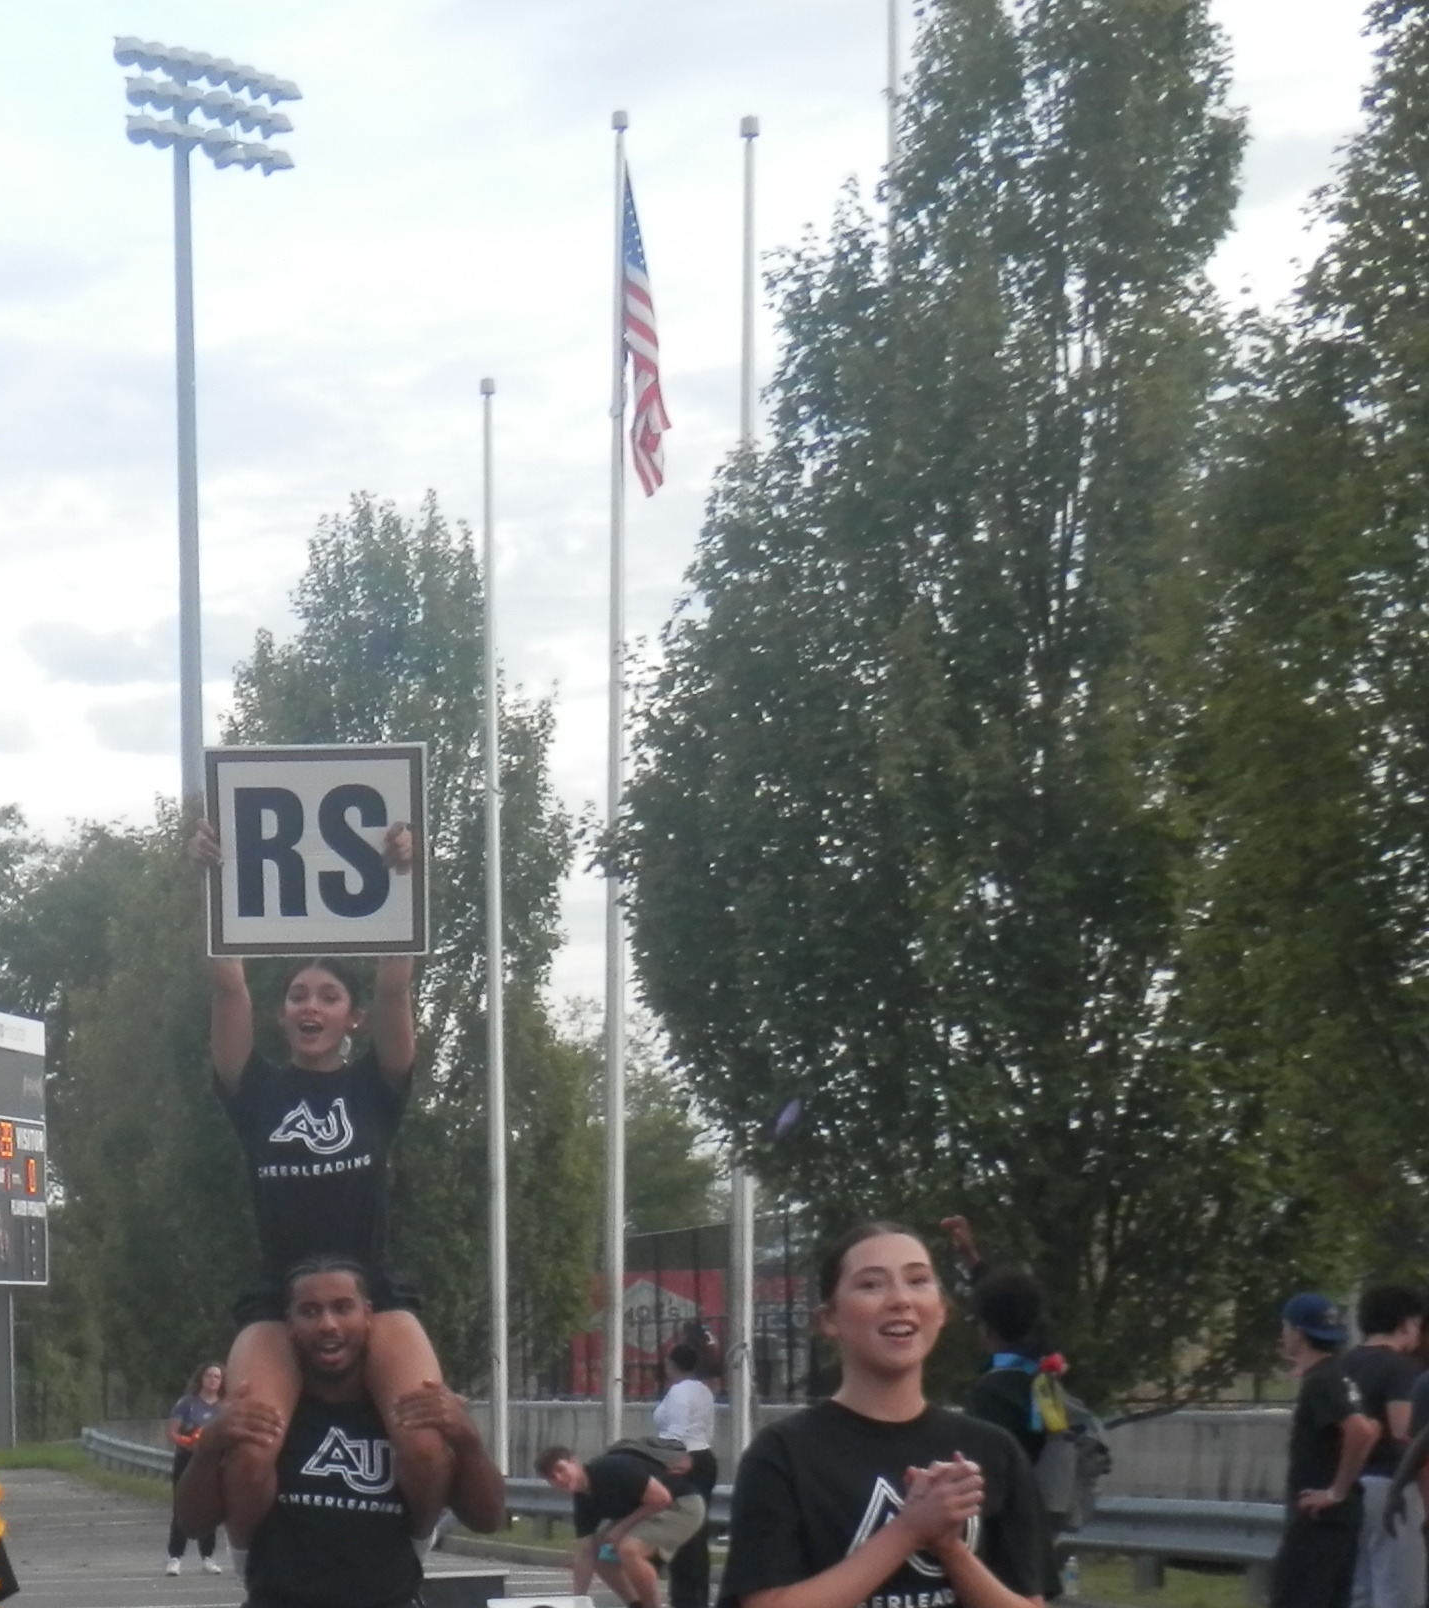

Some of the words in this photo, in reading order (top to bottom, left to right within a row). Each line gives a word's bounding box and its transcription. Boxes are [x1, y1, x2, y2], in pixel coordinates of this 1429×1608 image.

[234, 783, 390, 918] RS
[300, 1426, 397, 1494] AU
[278, 1493, 404, 1515] CHEERLEADING
